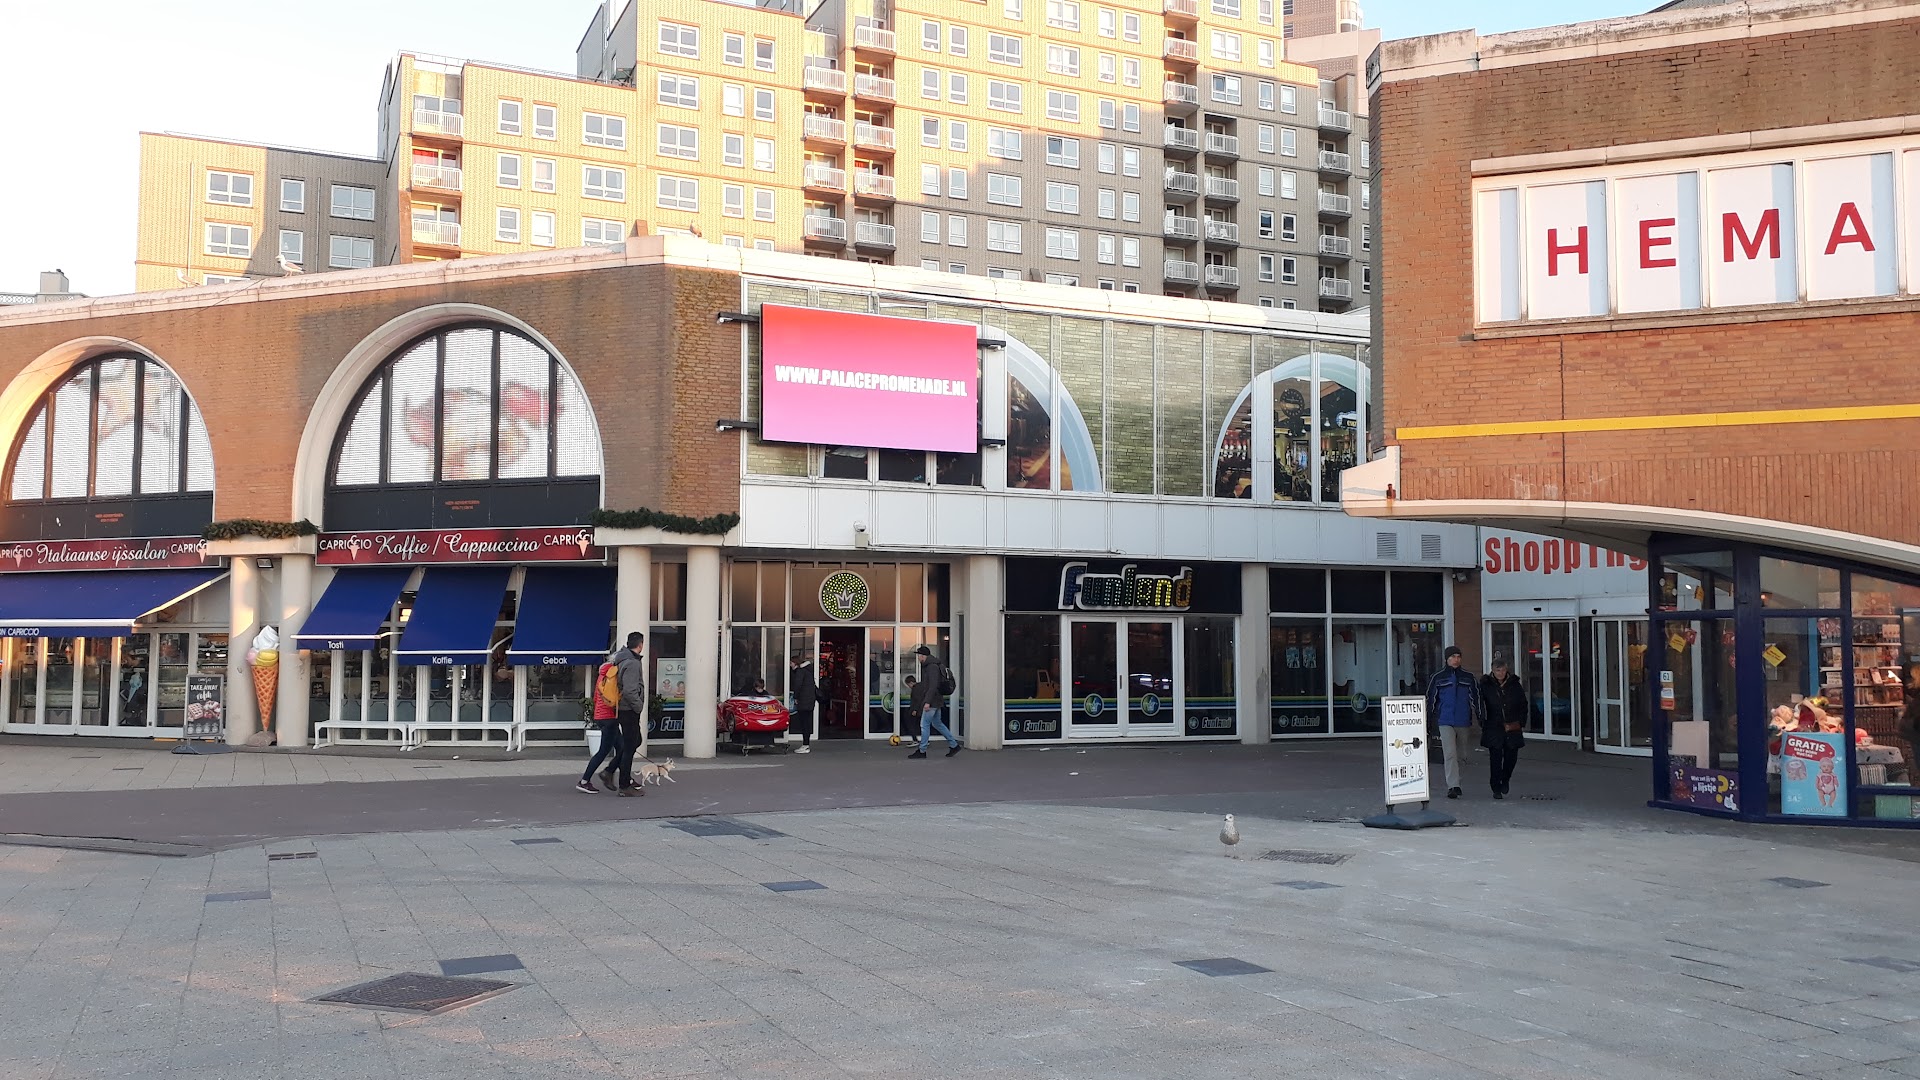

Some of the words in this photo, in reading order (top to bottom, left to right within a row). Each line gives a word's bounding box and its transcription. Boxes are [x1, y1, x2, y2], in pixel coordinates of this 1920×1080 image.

[1547, 202, 1876, 277] HEMA
[775, 364, 968, 397] WWW.PALACEPROMENADE.NL
[319, 535, 372, 551] CAPRICCIO
[543, 529, 596, 546] CAPRICCI
[36, 543, 110, 564] Italiaanse
[375, 534, 430, 561] Koffie
[443, 532, 541, 560] Cappuccino
[1059, 562, 1193, 611] Funland
[8, 627, 40, 636] CAPRICCIO
[327, 641, 344, 650] Tosti
[432, 656, 453, 665] Koffie
[542, 656, 567, 665] Gebak
[1386, 703, 1422, 714] TOILETTEN
[660, 716, 684, 732] Fun
[1023, 719, 1057, 732] Funland
[1201, 716, 1232, 729] Funland
[1290, 714, 1321, 728] Funland
[1396, 718, 1422, 726] RESTROOMS
[1787, 738, 1826, 753] GRATIS
